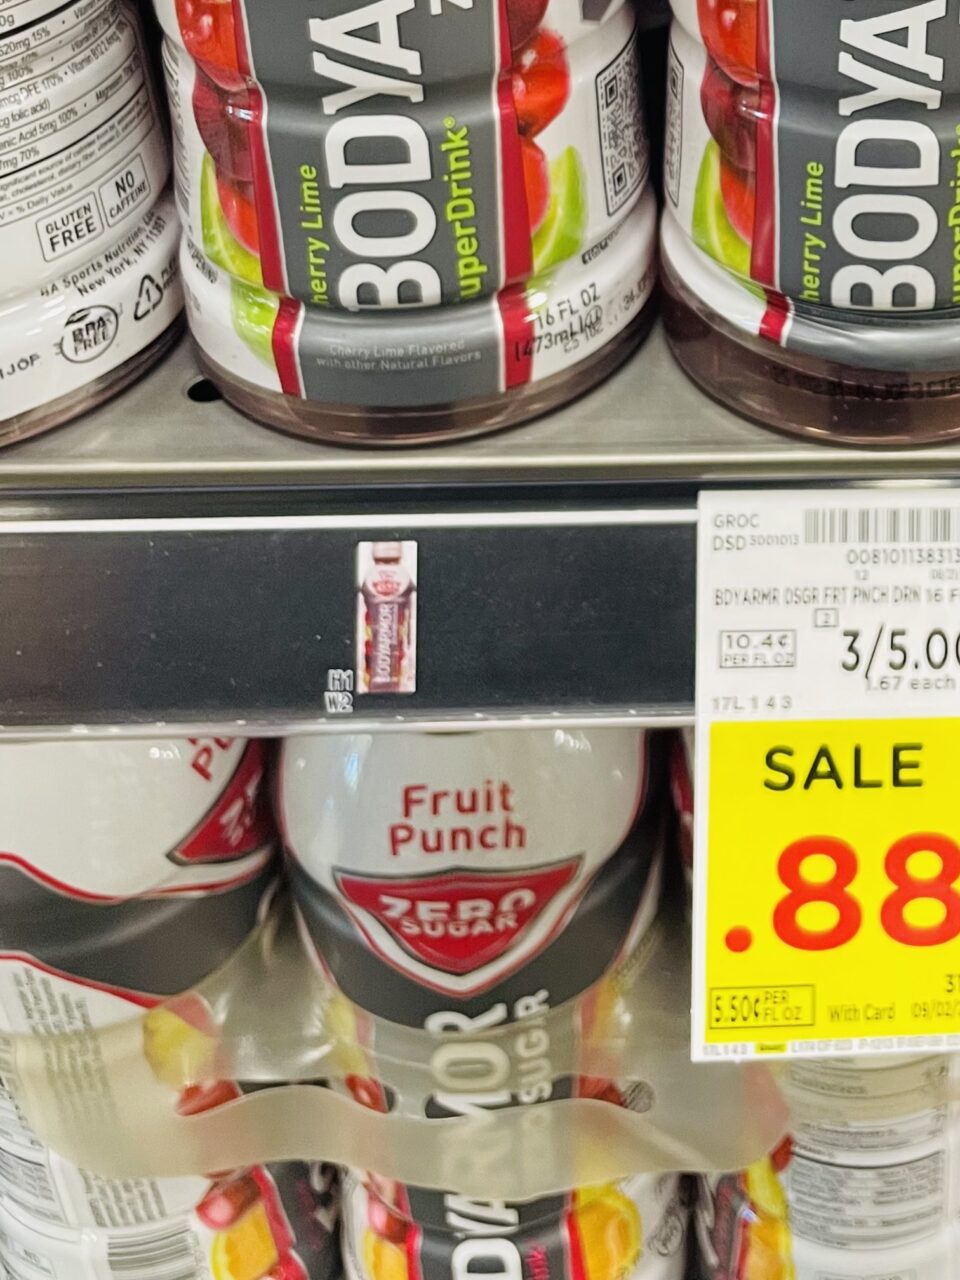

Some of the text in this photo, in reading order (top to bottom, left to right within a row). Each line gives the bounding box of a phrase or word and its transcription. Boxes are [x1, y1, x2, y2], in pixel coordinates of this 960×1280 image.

[114, 170, 136, 199] NO
[108, 180, 148, 220] CAFFEINE
[45, 203, 93, 235] GLUTEN
[800, 161, 827, 303] herry Lime
[49, 216, 97, 252] FREE
[300, 164, 330, 307] herry Lime
[63, 260, 102, 289] Sports
[78, 276, 107, 298] New
[108, 257, 138, 283] York,
[537, 308, 555, 330] 16
[557, 299, 579, 322] FL
[580, 282, 601, 308] OZ
[316, 350, 482, 371] with other Natural Flavors
[373, 342, 405, 357] Lime
[408, 339, 465, 356] Flavored
[713, 513, 760, 529] GROC
[713, 535, 747, 551] DSD
[714, 587, 780, 606] BDYARMR
[823, 586, 848, 604] FRT
[852, 586, 889, 604] PNCH
[926, 587, 944, 603] 16
[723, 651, 795, 666] PER FL OZ
[866, 673, 956, 691] 1.67 each
[763, 742, 924, 792] SALE
[402, 780, 515, 820] Fruit
[389, 820, 526, 857] Punch
[400, 912, 517, 937] SUGAR
[764, 990, 788, 1005] PER
[828, 1004, 860, 1022] With
[864, 1001, 896, 1021] Card
